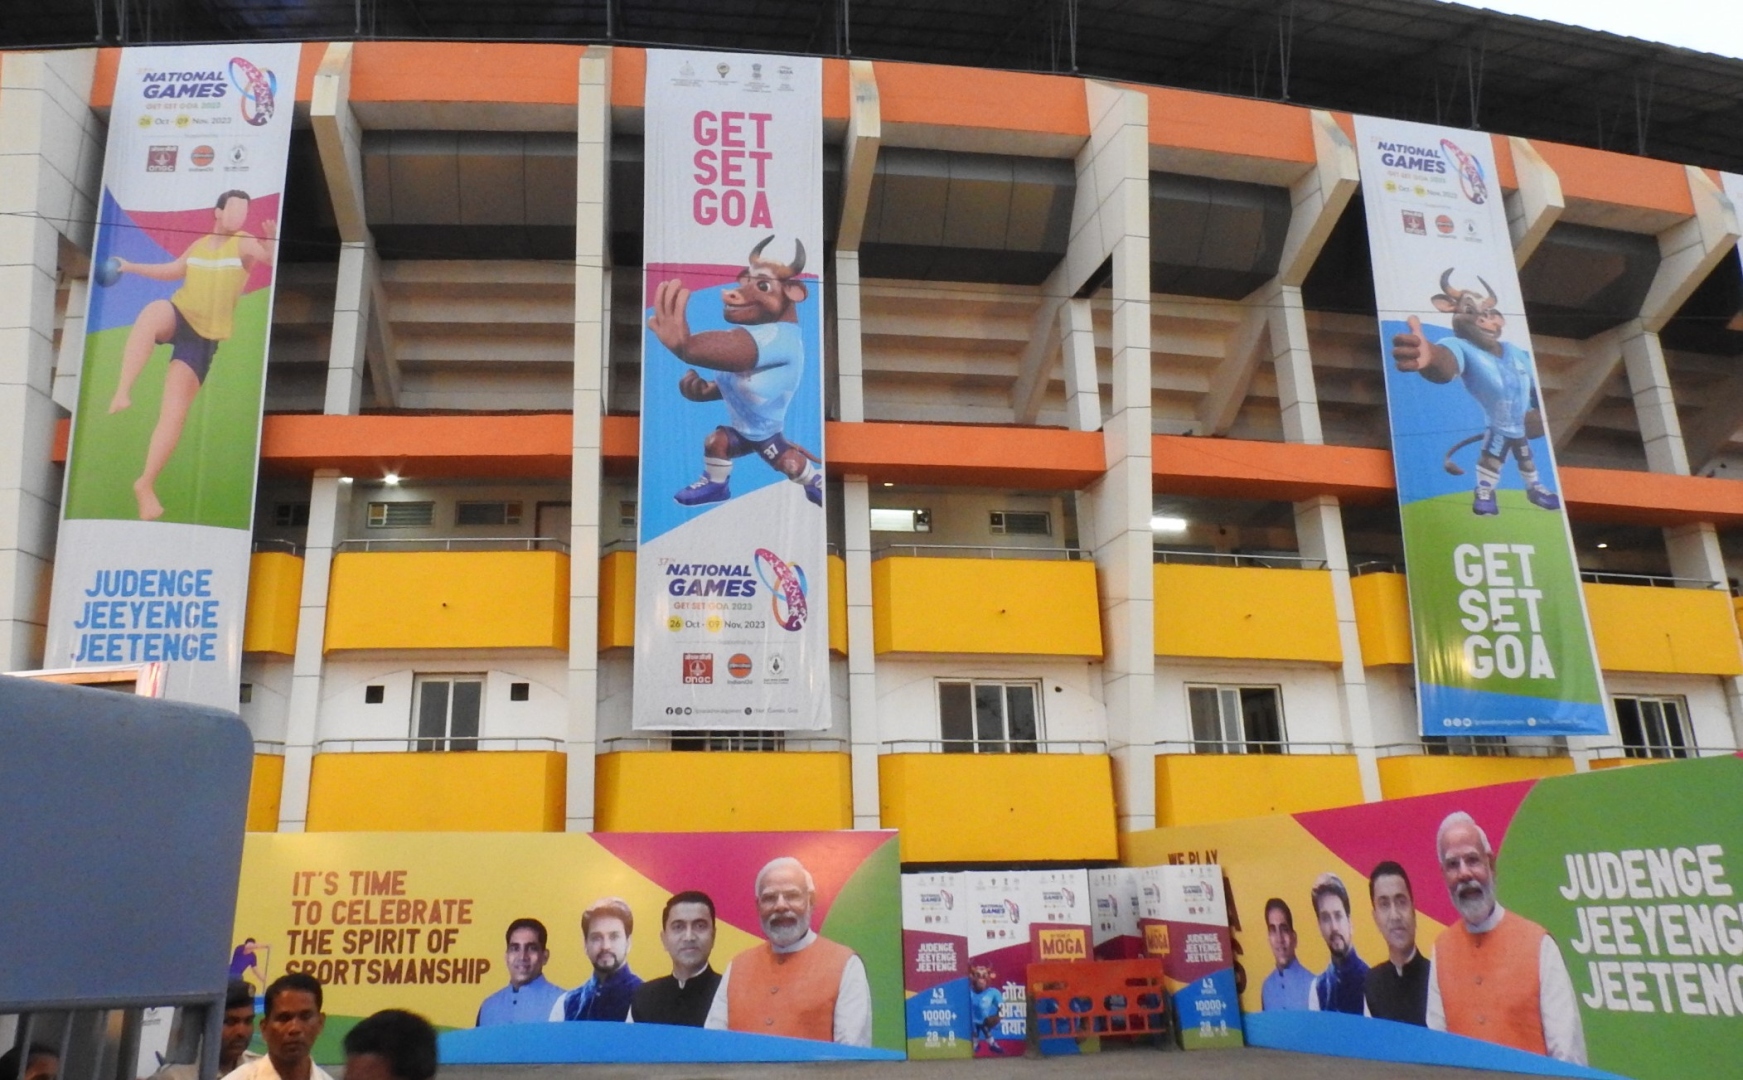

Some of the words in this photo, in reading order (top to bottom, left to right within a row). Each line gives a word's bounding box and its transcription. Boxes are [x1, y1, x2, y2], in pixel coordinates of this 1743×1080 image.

[142, 71, 224, 82] NATIONAL
[144, 83, 228, 98] GAMES
[694, 110, 772, 149] GET
[1378, 142, 1441, 158] NATIONAL
[694, 149, 772, 188] SET
[1381, 153, 1446, 174] GAMES
[693, 188, 773, 228] GOA
[764, 443, 778, 460] 37
[666, 564, 752, 577] NATIONAL
[1454, 543, 1535, 587] GET
[85, 569, 212, 597] JUDENGE
[669, 579, 757, 597] GAMES
[74, 600, 219, 629] JEEYENGE
[1458, 588, 1543, 632] SET
[670, 619, 681, 628] 26
[708, 620, 720, 628] 09
[71, 633, 218, 662] JEETENGE
[1464, 634, 1555, 679] GOA
[292, 871, 339, 896] IT'S
[349, 870, 407, 896] TIME
[1560, 844, 1733, 900] JUDENGE
[292, 901, 322, 926] TO
[331, 899, 474, 925] CELEBRATE
[287, 930, 334, 955] THE
[342, 929, 421, 954] SPIRIT
[427, 928, 459, 954] OF
[1571, 902, 1743, 956] JEEYENG
[918, 943, 954, 952] JUDENGE
[1042, 938, 1083, 955] MOGA
[285, 959, 490, 985] SPORTSMANSHIP
[1202, 978, 1214, 988] 43
[933, 988, 944, 999] 43
[1195, 1000, 1227, 1011] 10000+
[923, 1010, 957, 1021] 10000+
